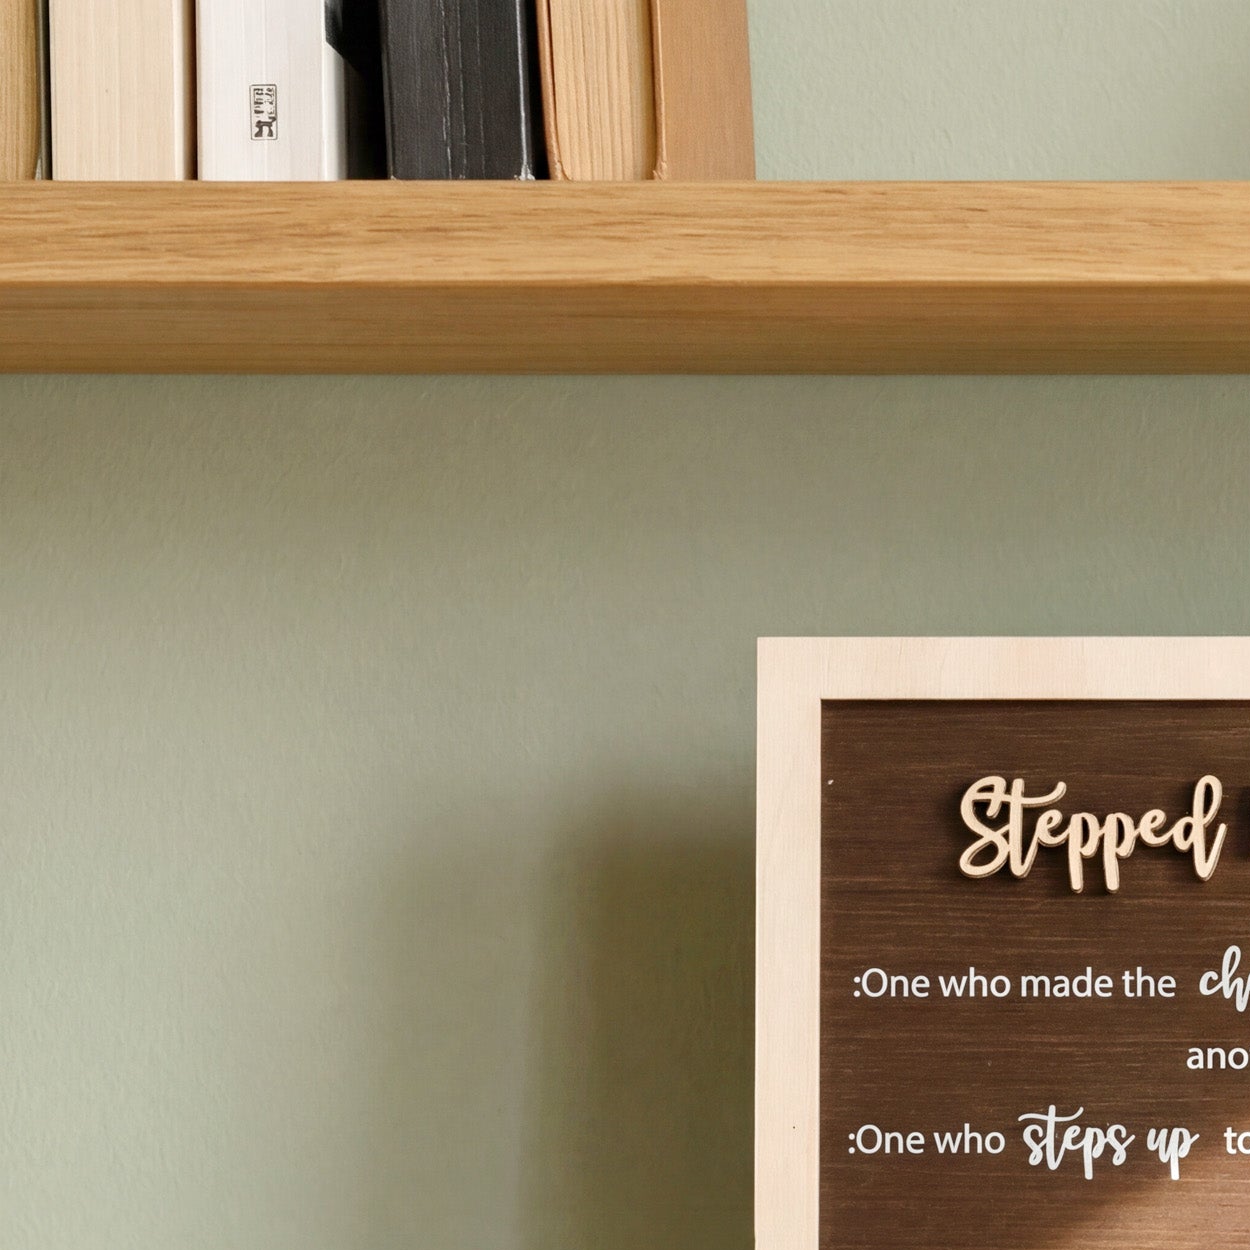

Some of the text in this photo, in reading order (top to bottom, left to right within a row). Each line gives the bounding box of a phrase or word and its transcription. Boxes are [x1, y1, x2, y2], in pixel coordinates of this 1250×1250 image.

[959, 774, 1227, 893] Stepped
[853, 967, 930, 998] :One
[938, 966, 1011, 998] who
[1021, 966, 1113, 998] made
[1121, 966, 1176, 998] the
[847, 1124, 925, 1154] :One
[933, 1123, 1005, 1154] who
[1018, 1104, 1136, 1180] steps
[1146, 1127, 1200, 1181] up
